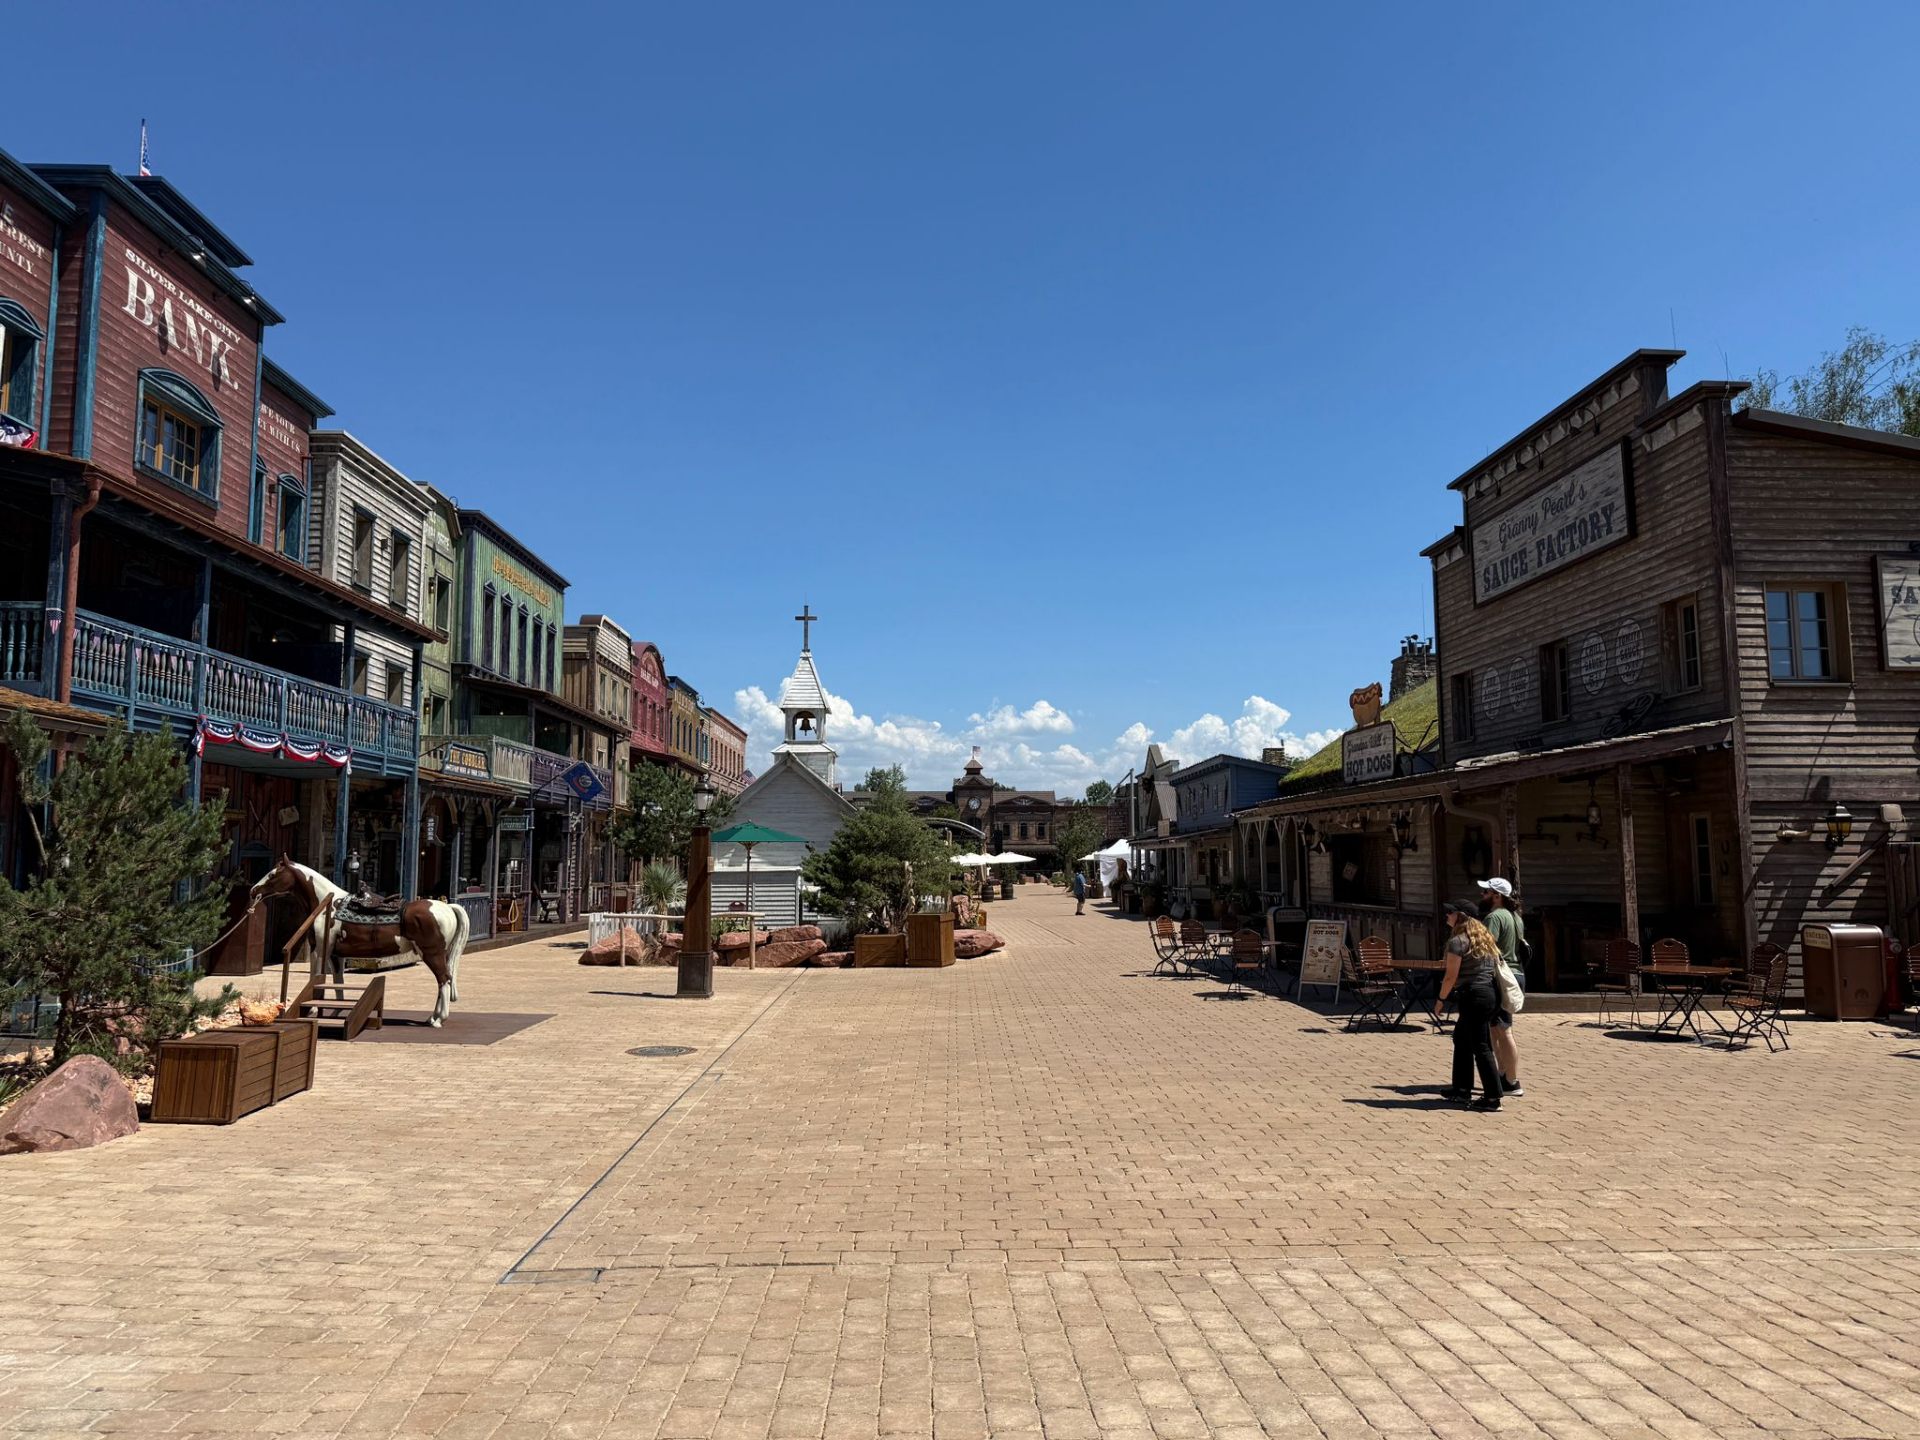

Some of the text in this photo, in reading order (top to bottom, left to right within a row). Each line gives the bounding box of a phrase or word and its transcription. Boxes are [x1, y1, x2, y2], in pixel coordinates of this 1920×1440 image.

[121, 265, 240, 391] BANK.
[124, 248, 241, 345] SILVER LAKE CITY
[269, 425, 290, 447] WITH
[1483, 501, 1617, 594] SAUCE FACTORY
[1498, 479, 1588, 553] Granny Pearl's
[1346, 752, 1392, 778] HOT DOGS
